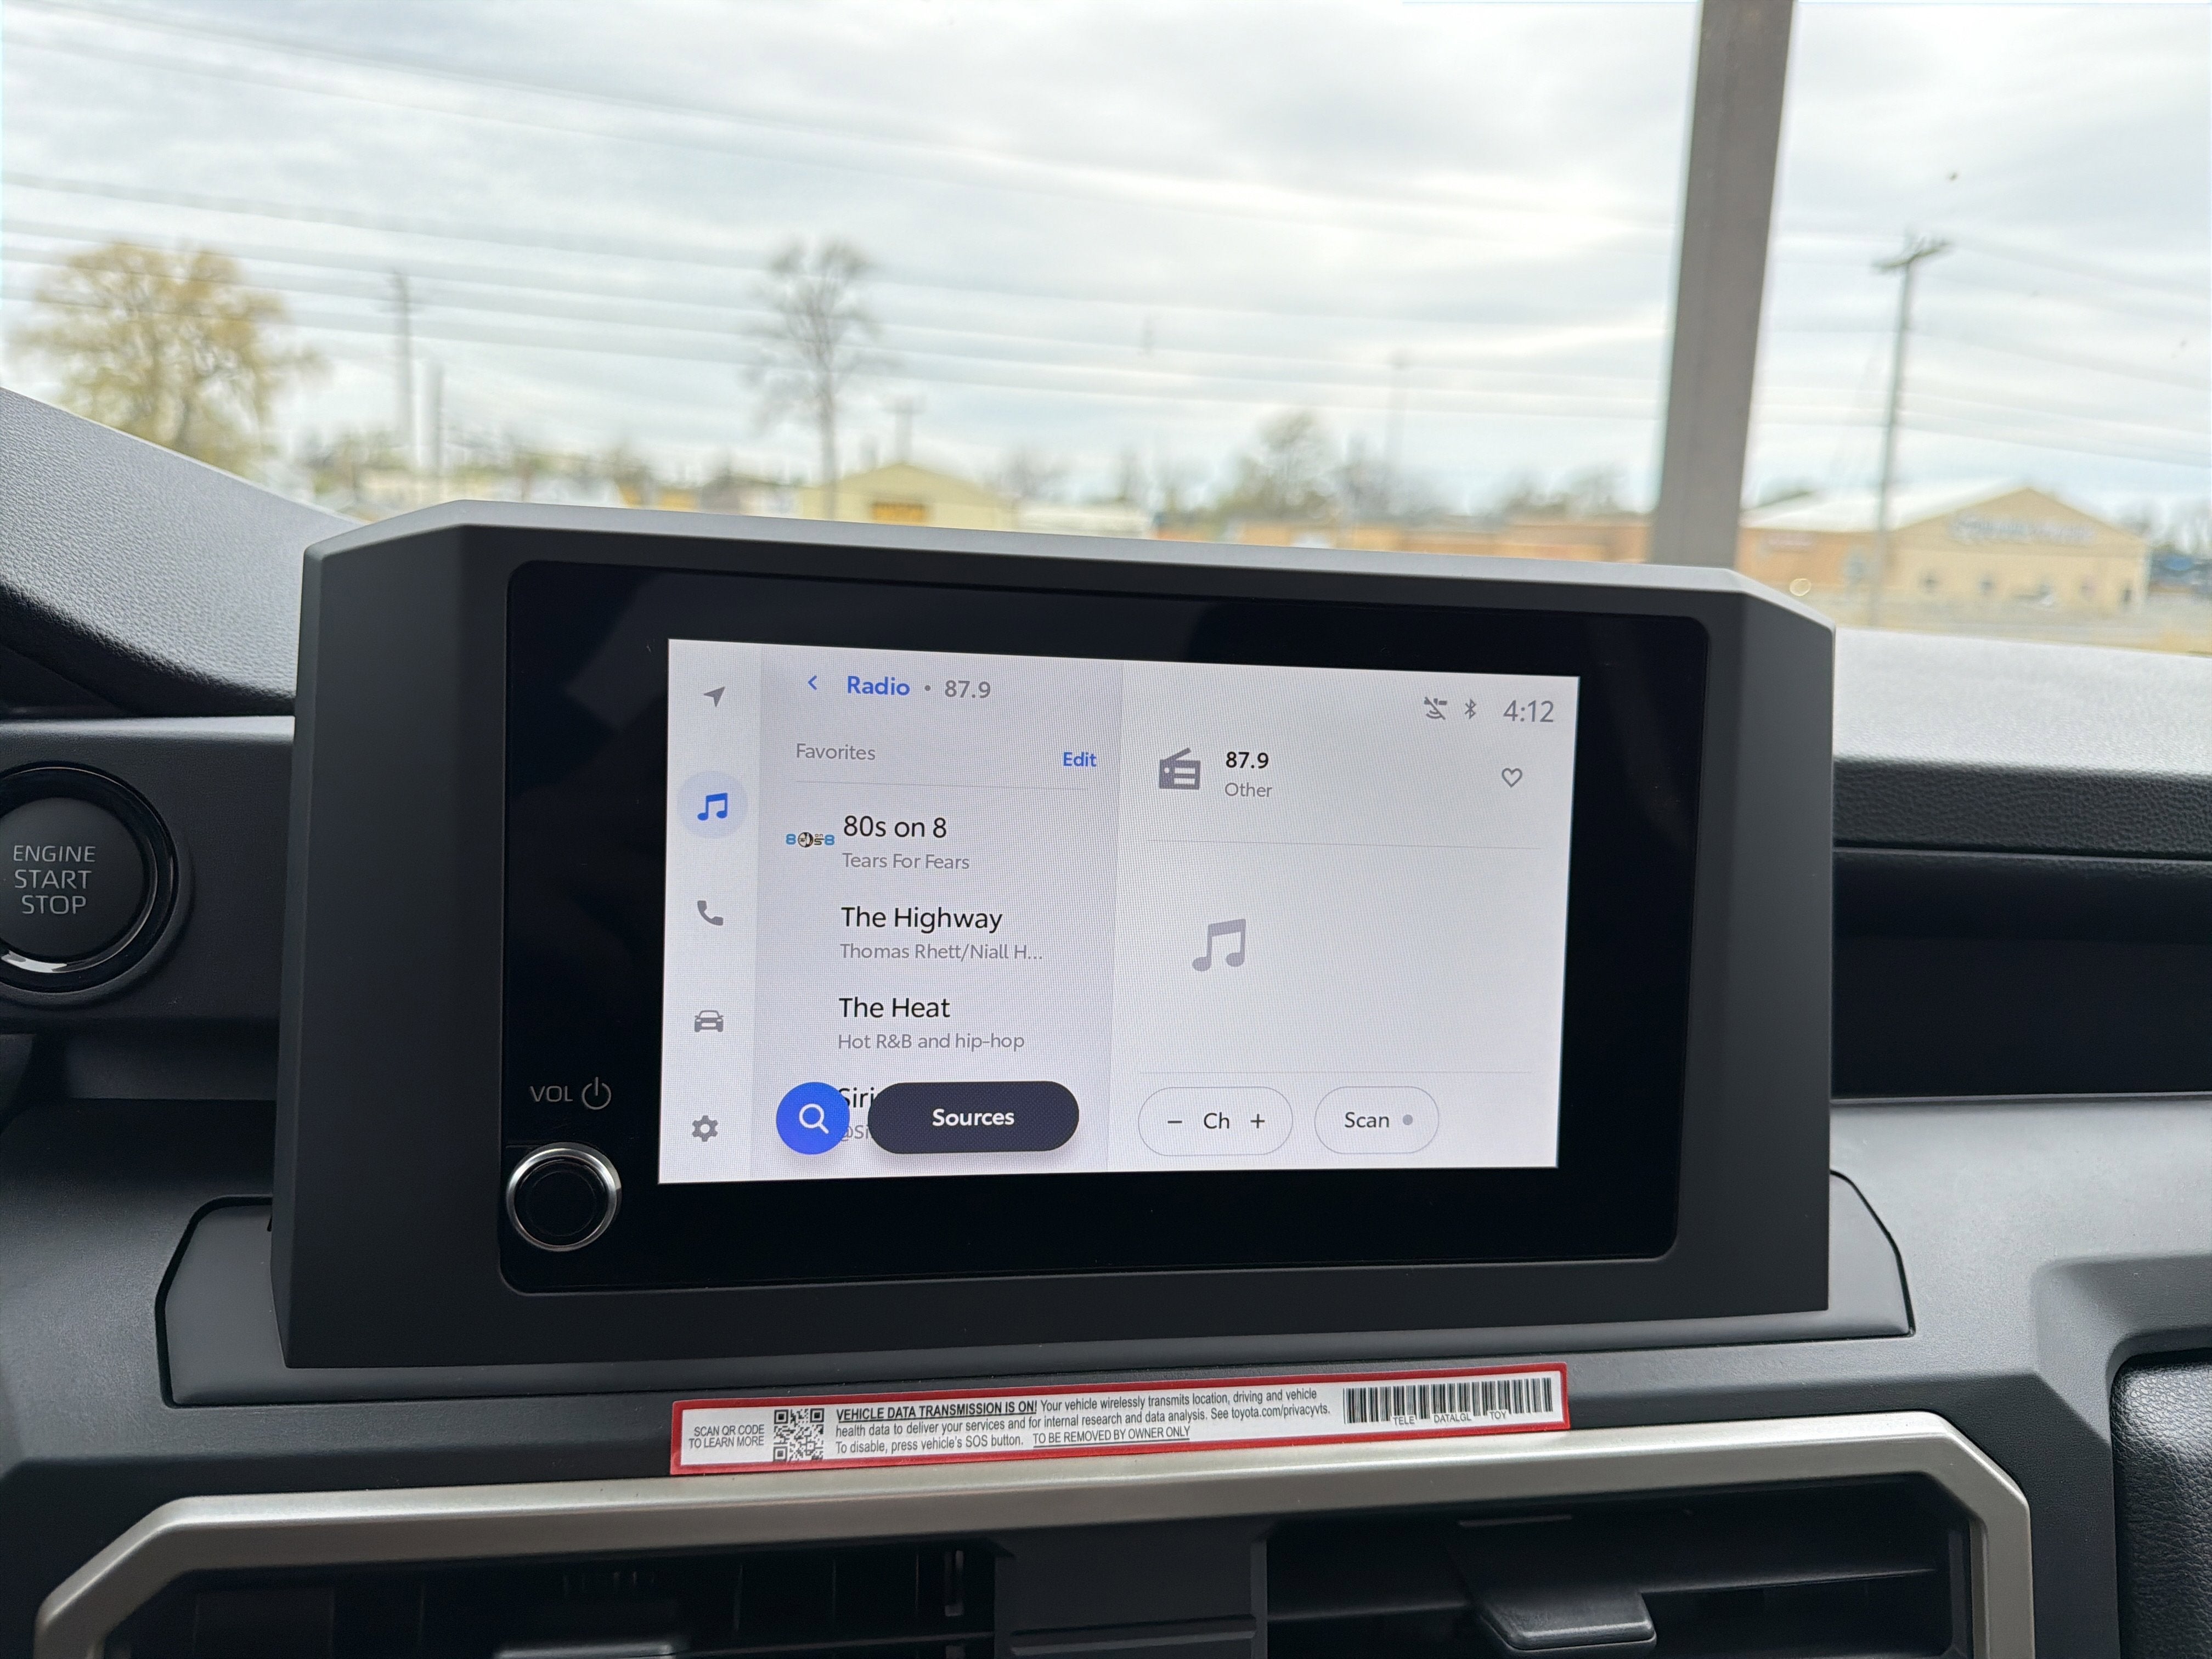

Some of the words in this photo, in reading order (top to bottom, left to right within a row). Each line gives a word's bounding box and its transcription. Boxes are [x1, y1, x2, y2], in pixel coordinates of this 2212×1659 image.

[847, 675, 910, 696] Radio
[945, 680, 991, 699] 87.9
[1503, 700, 1554, 723] 4:12
[797, 743, 876, 761] Favorites
[1063, 751, 1097, 767] Edit
[1226, 752, 1269, 769] 87.9
[1224, 782, 1273, 798] Other
[844, 815, 887, 837] 80s
[894, 821, 925, 838] on
[933, 817, 947, 838] 8
[13, 845, 96, 862] ENGINE
[842, 853, 888, 868] Tears
[893, 854, 921, 869] For
[925, 854, 970, 870] Fears
[14, 870, 92, 889] START
[21, 895, 86, 915] STOP
[841, 906, 887, 928] The
[894, 907, 1003, 934] Highway
[840, 943, 910, 959] Thomas
[915, 943, 1009, 962] Rhett/Niall
[839, 997, 884, 1018] The
[893, 997, 951, 1018] Heat
[838, 1034, 871, 1049] Hot
[877, 1034, 912, 1049] R&B
[917, 1033, 950, 1049] and
[955, 1032, 1025, 1052] hip-hop
[530, 1086, 573, 1102] VOL
[932, 1109, 1014, 1127] Sources
[1203, 1112, 1230, 1130] Ch
[1344, 1111, 1390, 1128] Scan
[836, 1407, 884, 1421] VEHICLE
[887, 1406, 917, 1419] DATA
[919, 1402, 1002, 1418] TRANSMISSION
[1005, 1402, 1015, 1414] IS
[1018, 1401, 1037, 1413] ON!
[1041, 1400, 1062, 1412] Your
[1064, 1398, 1097, 1410] vehicle
[1100, 1395, 1145, 1410] wirelessly
[1148, 1393, 1189, 1407] transmits
[1193, 1392, 1230, 1405] location,
[1233, 1390, 1262, 1404] driving
[1266, 1389, 1283, 1401] and
[1285, 1387, 1317, 1400] vehicle
[836, 1424, 866, 1437] health
[868, 1423, 890, 1436] data
[894, 1423, 903, 1435] to
[906, 1421, 938, 1435] deliver
[941, 1423, 963, 1436] your
[966, 1418, 1005, 1431] services
[1008, 1416, 1025, 1429] and
[1029, 1416, 1041, 1428] for
[1044, 1414, 1078, 1426] internal
[1082, 1412, 1122, 1425] research
[1125, 1411, 1142, 1424] and
[1145, 1410, 1165, 1423] data
[1168, 1407, 1207, 1423] analysis.
[1211, 1407, 1229, 1419] See
[1232, 1402, 1330, 1420] toyota.com/privacyvts.
[1393, 1416, 1415, 1425] TELE
[1434, 1412, 1472, 1423] DATALGL
[1489, 1410, 1508, 1420] TOY
[694, 1426, 720, 1437] SCAN
[722, 1425, 740, 1436] QR
[740, 1424, 765, 1436] CODE
[836, 1441, 847, 1454] To
[850, 1440, 888, 1453] disable,
[891, 1441, 917, 1454] press
[921, 1436, 962, 1451] vehicle's
[966, 1435, 988, 1447] SOS
[991, 1434, 1024, 1447] button.
[1033, 1433, 1046, 1444] TO
[1048, 1431, 1062, 1443] BE
[1064, 1429, 1111, 1443] REMOVED
[1114, 1429, 1126, 1441] BY
[1128, 1427, 1164, 1440] OWNER
[1166, 1425, 1190, 1437] ONLY
[689, 1437, 703, 1448] TO
[704, 1436, 735, 1448] LEARN
[737, 1436, 765, 1447] MORE
